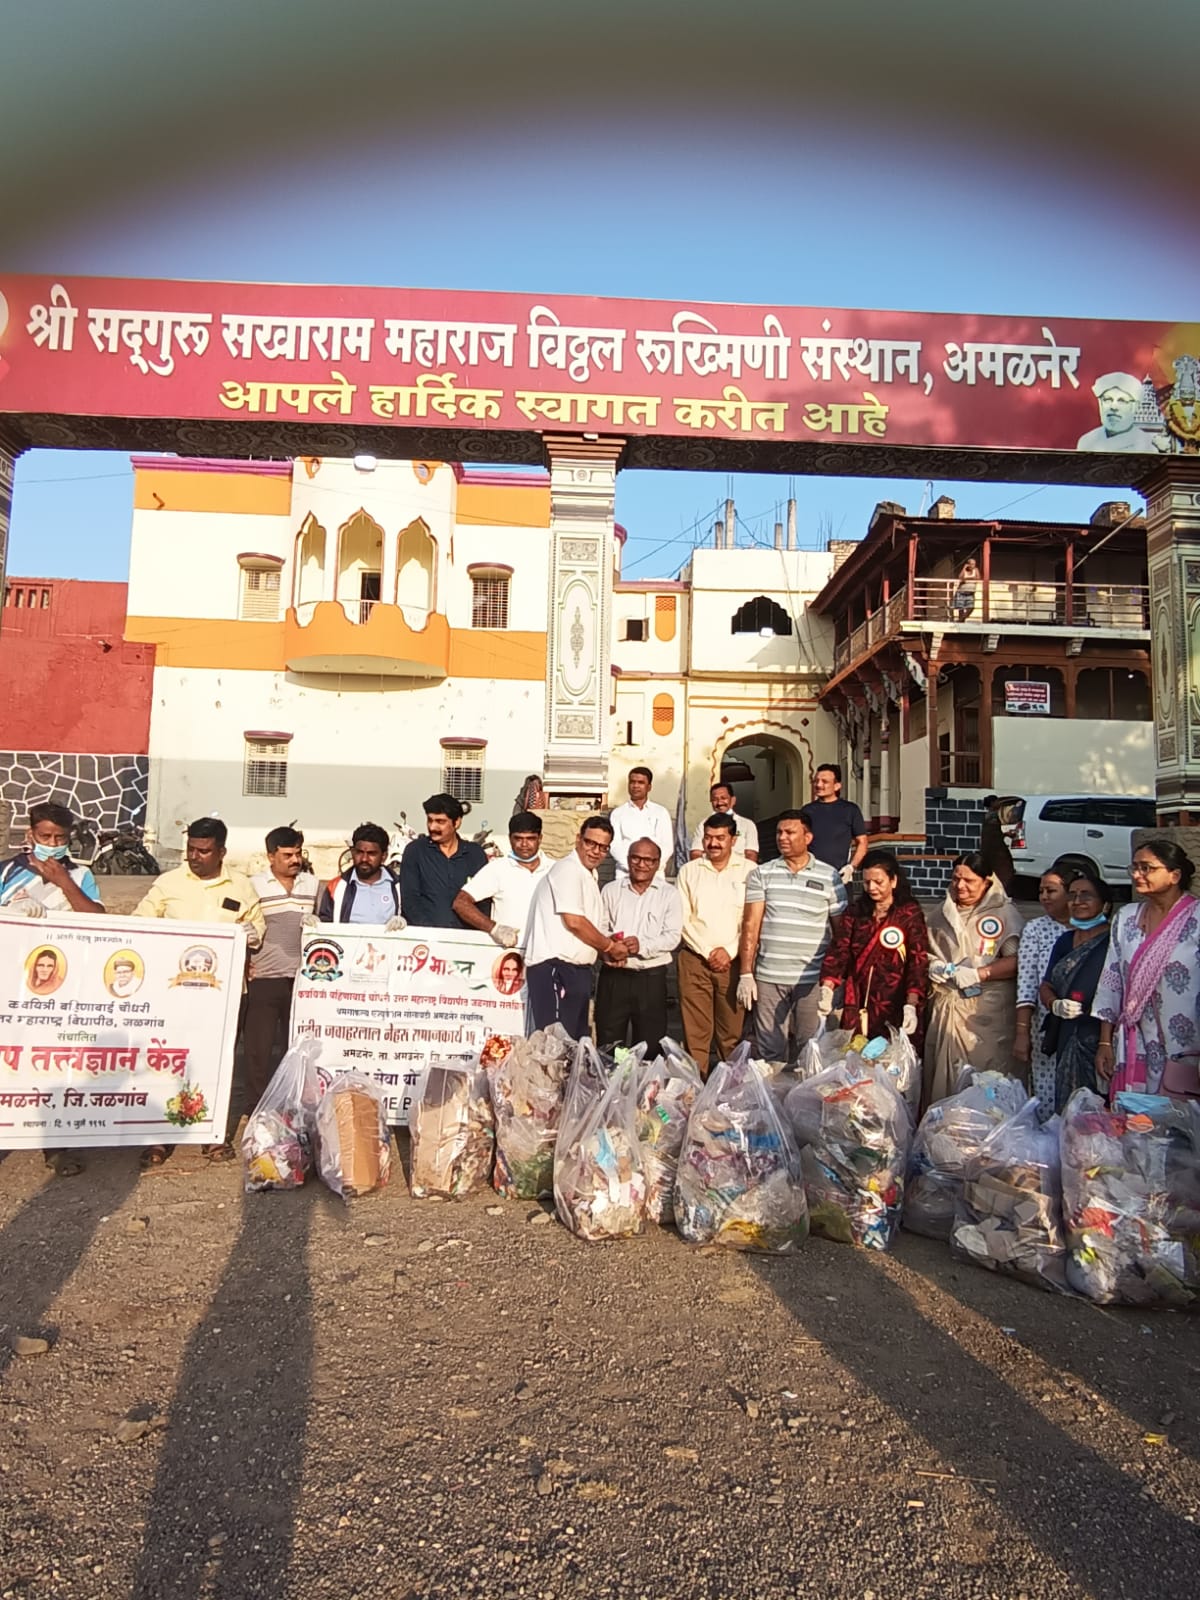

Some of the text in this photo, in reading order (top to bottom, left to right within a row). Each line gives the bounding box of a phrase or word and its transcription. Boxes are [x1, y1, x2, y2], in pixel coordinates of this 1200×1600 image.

[26, 283, 78, 351] श्री
[221, 314, 375, 362] सखाराम
[384, 319, 517, 369] महाराज
[526, 305, 627, 383] विठ्ठल
[800, 318, 934, 395] संस्थान,
[943, 327, 1081, 389] अमळनेर
[219, 372, 889, 438] आपले हार्दिक स्वागत करीत आहे
[118, 1001, 151, 1014] चौधरी
[324, 1025, 381, 1041] जवाहरलाल
[146, 1037, 190, 1078] केंद्र
[373, 1068, 399, 1086] सेवा
[0, 1088, 56, 1109] मळनेर,
